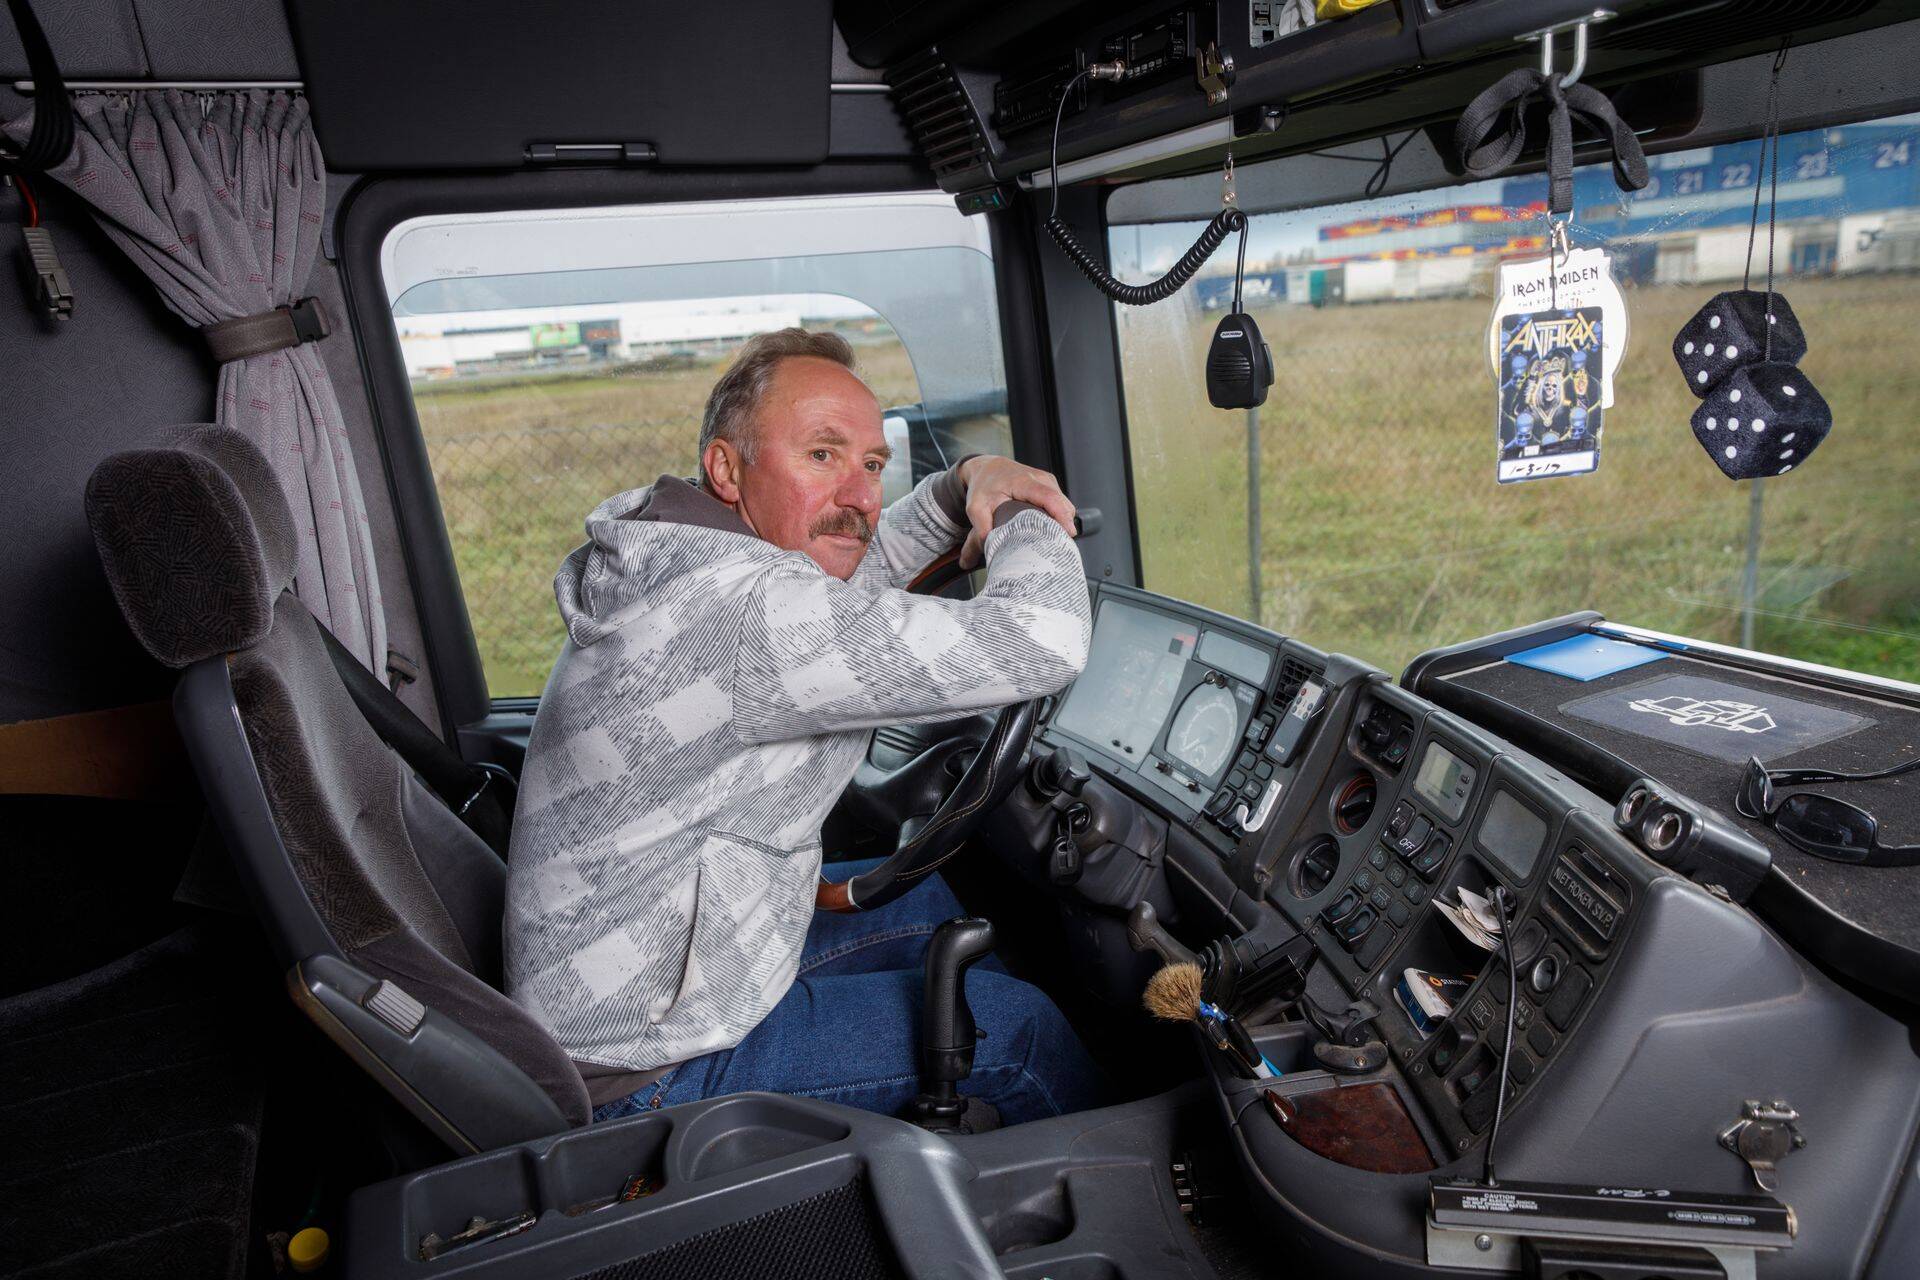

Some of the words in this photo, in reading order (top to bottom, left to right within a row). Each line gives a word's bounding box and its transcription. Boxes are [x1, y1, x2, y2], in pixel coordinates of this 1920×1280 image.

[1875, 142, 1909, 169] 24
[1678, 171, 1704, 194] 21
[1722, 164, 1751, 187] 22
[1513, 278, 1545, 297] IRON
[1549, 266, 1599, 290] MAIDEN
[1504, 312, 1599, 360] ANTHRAX
[1399, 838, 1416, 850] OFF
[1554, 867, 1572, 887] NIET
[1568, 881, 1595, 909] ROKEN
